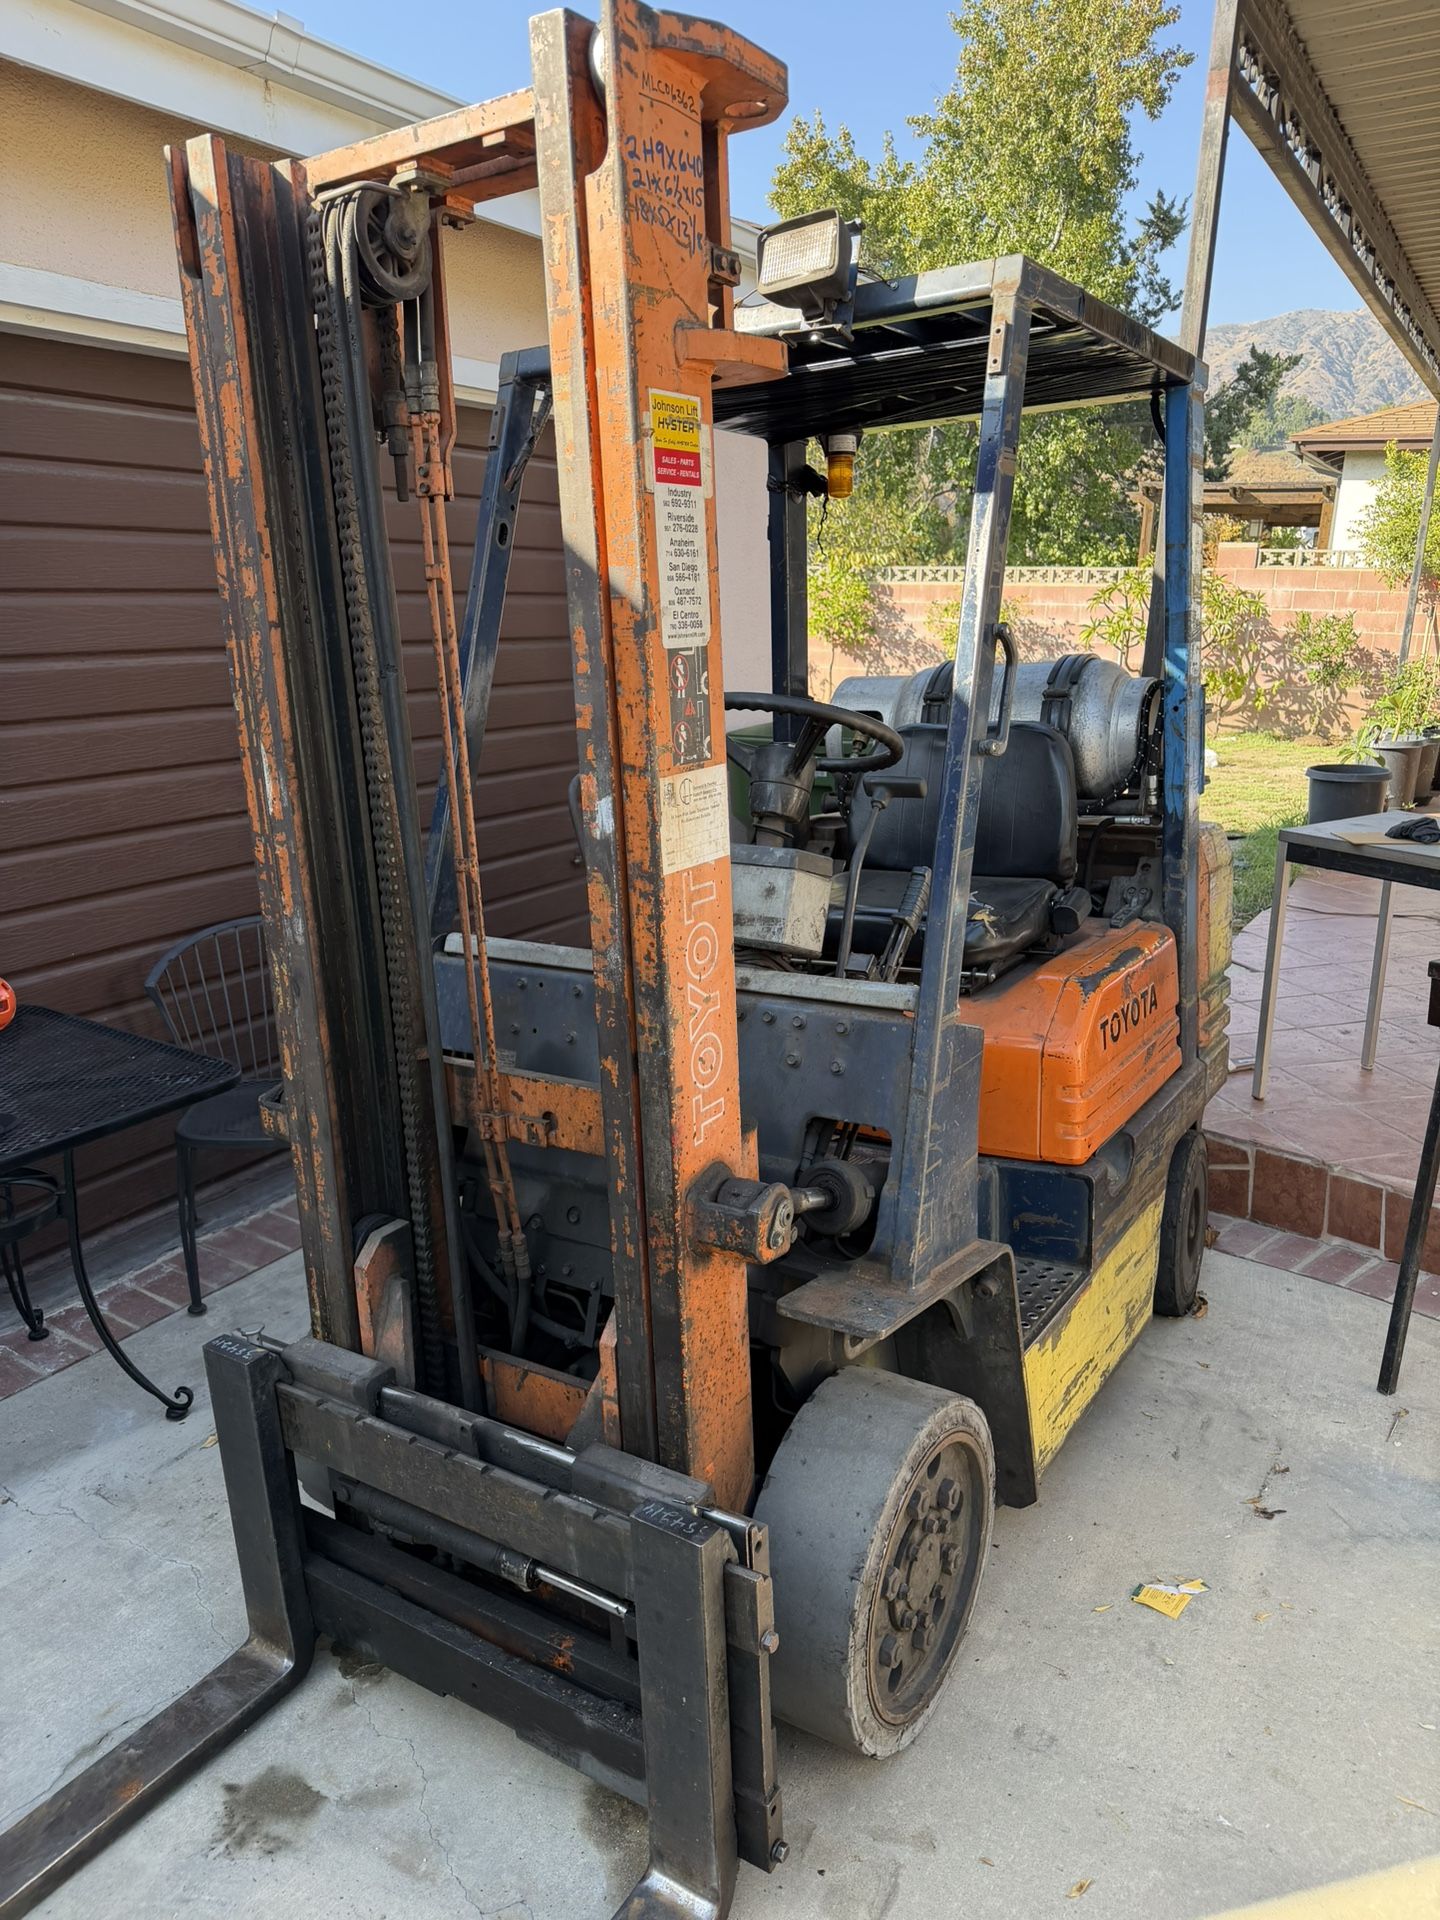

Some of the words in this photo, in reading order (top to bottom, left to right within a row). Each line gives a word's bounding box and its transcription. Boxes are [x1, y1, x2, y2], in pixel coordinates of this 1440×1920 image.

[652, 398, 685, 415] Johnson
[686, 404, 698, 417] Lift
[657, 416, 694, 433] HYSTER
[662, 456, 677, 465] SALES
[680, 458, 694, 467] PARTS
[657, 467, 677, 477] SERVICE
[680, 470, 700, 479] RENTALS
[667, 487, 692, 499] Industry
[671, 498, 697, 509] 692-9311
[667, 512, 694, 523] Riverside
[669, 537, 695, 547] Anaheim
[668, 562, 680, 571] San
[682, 562, 698, 573] Diego
[674, 586, 695, 595] Oxnard
[672, 610, 678, 620] El
[680, 610, 699, 620] Centro
[681, 860, 725, 1147] TOYOT
[1099, 983, 1158, 1051] TOYOTA
